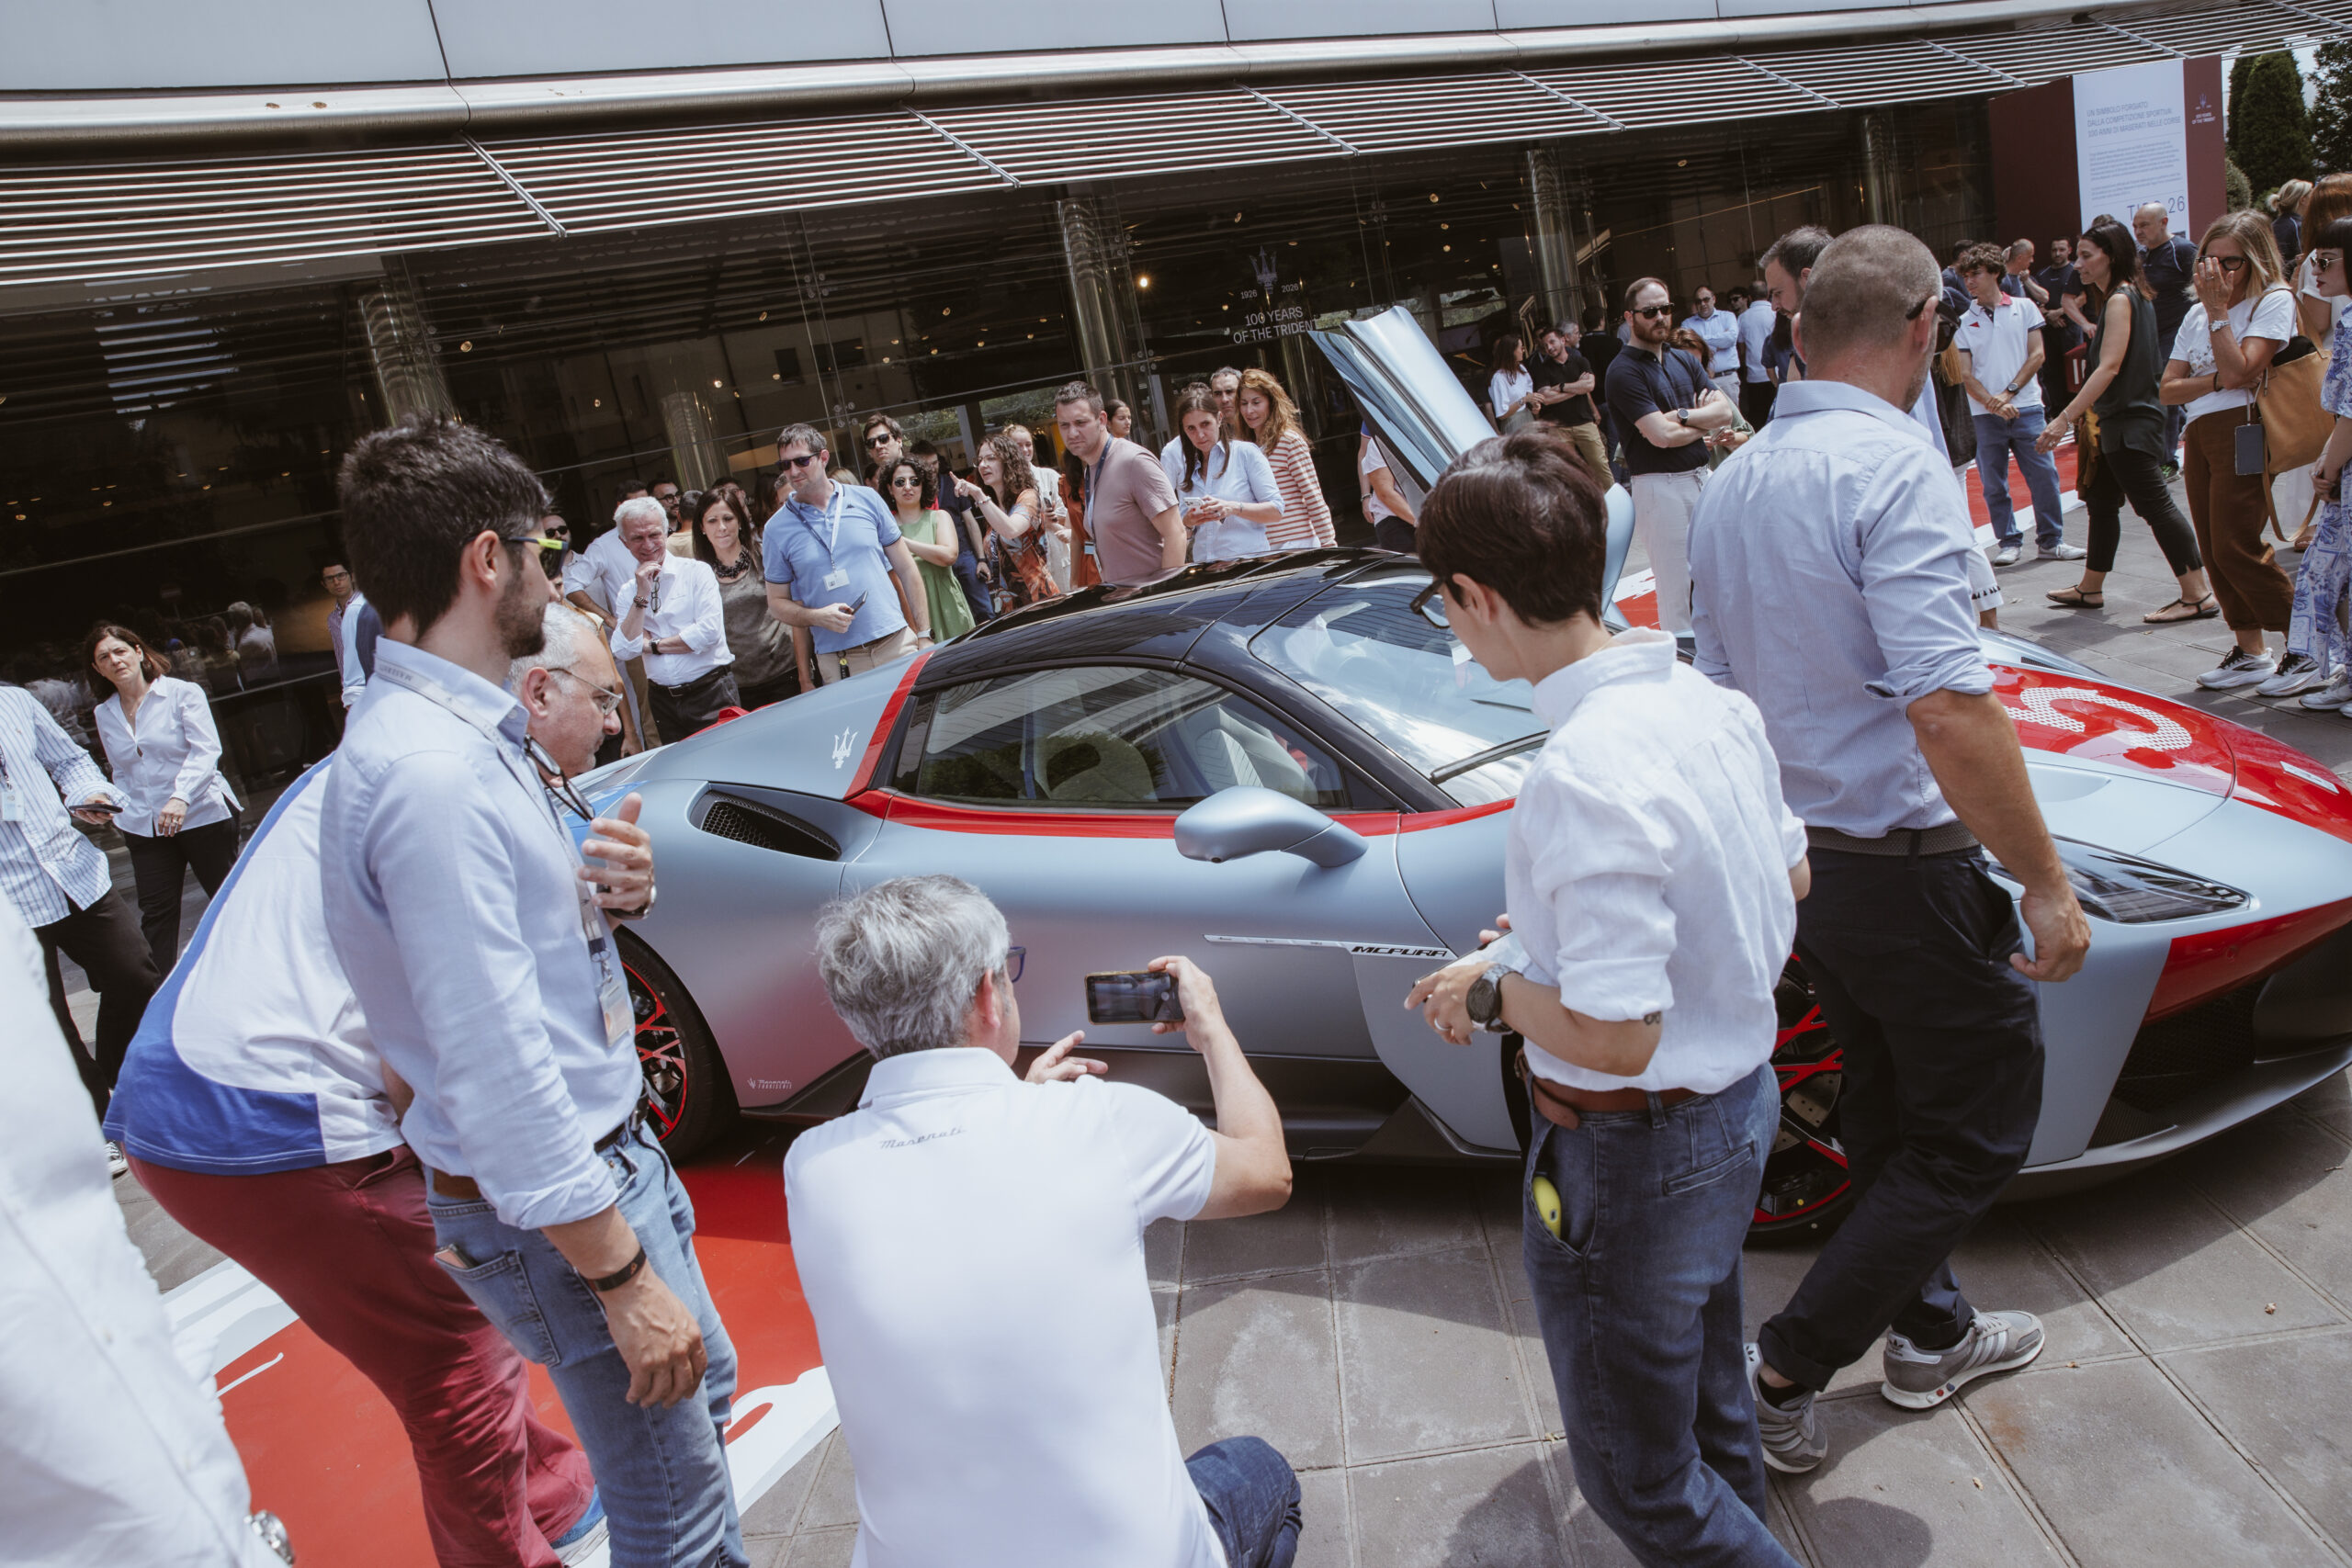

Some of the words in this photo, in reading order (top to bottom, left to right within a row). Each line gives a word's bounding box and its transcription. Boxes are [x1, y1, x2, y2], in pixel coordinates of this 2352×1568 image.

[2168, 196, 2185, 213] 26
[1240, 289, 1258, 299] 1926
[1245, 313, 1265, 327] 100
[1267, 306, 1304, 322] YEARS
[1233, 331, 1249, 344] OF
[1250, 327, 1272, 341] THE
[1273, 319, 1318, 338] TRIDENT
[1351, 946, 1448, 957] MCPURA
[880, 1125, 967, 1149] Maserati
